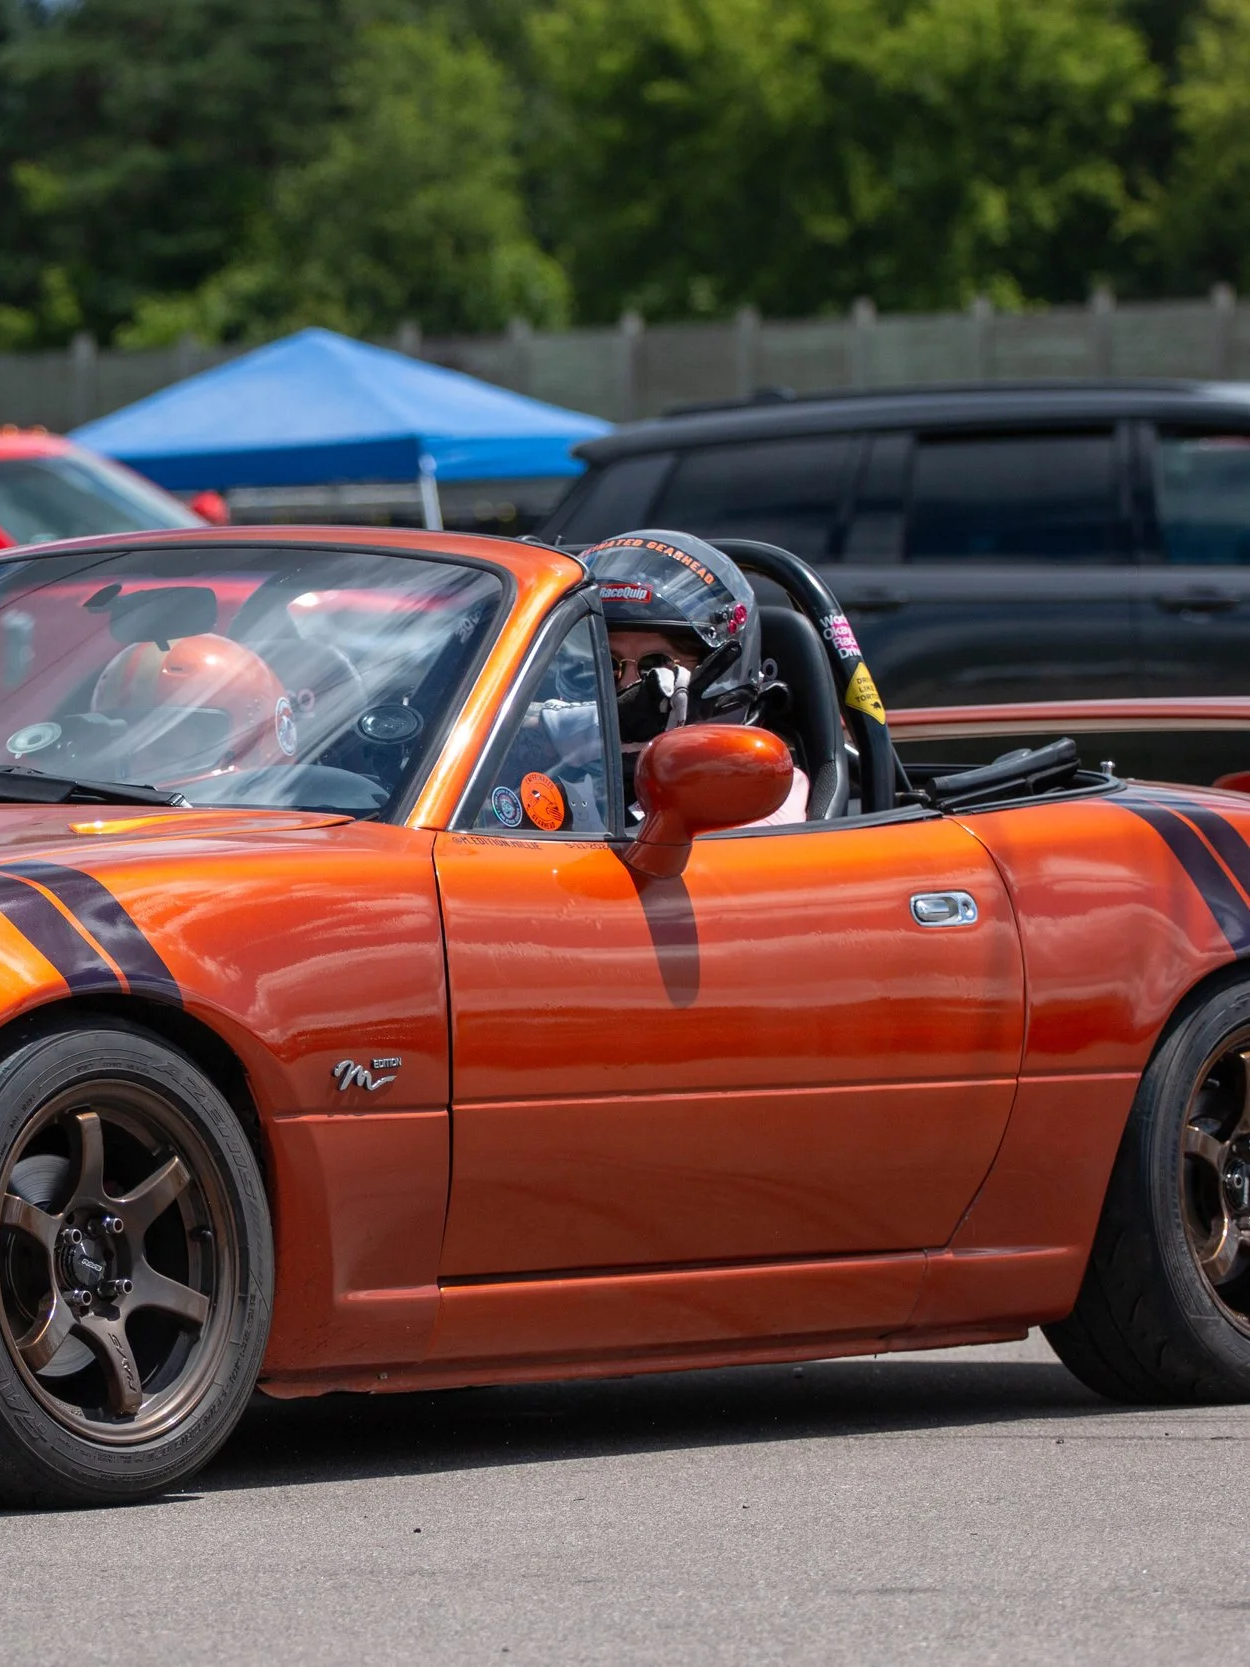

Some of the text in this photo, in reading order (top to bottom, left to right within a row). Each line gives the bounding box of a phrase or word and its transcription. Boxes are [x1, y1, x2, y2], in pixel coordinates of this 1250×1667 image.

[645, 541, 715, 585] GEARHEAD
[599, 587, 648, 600] RaceQuip
[373, 1057, 402, 1069] EDITION
